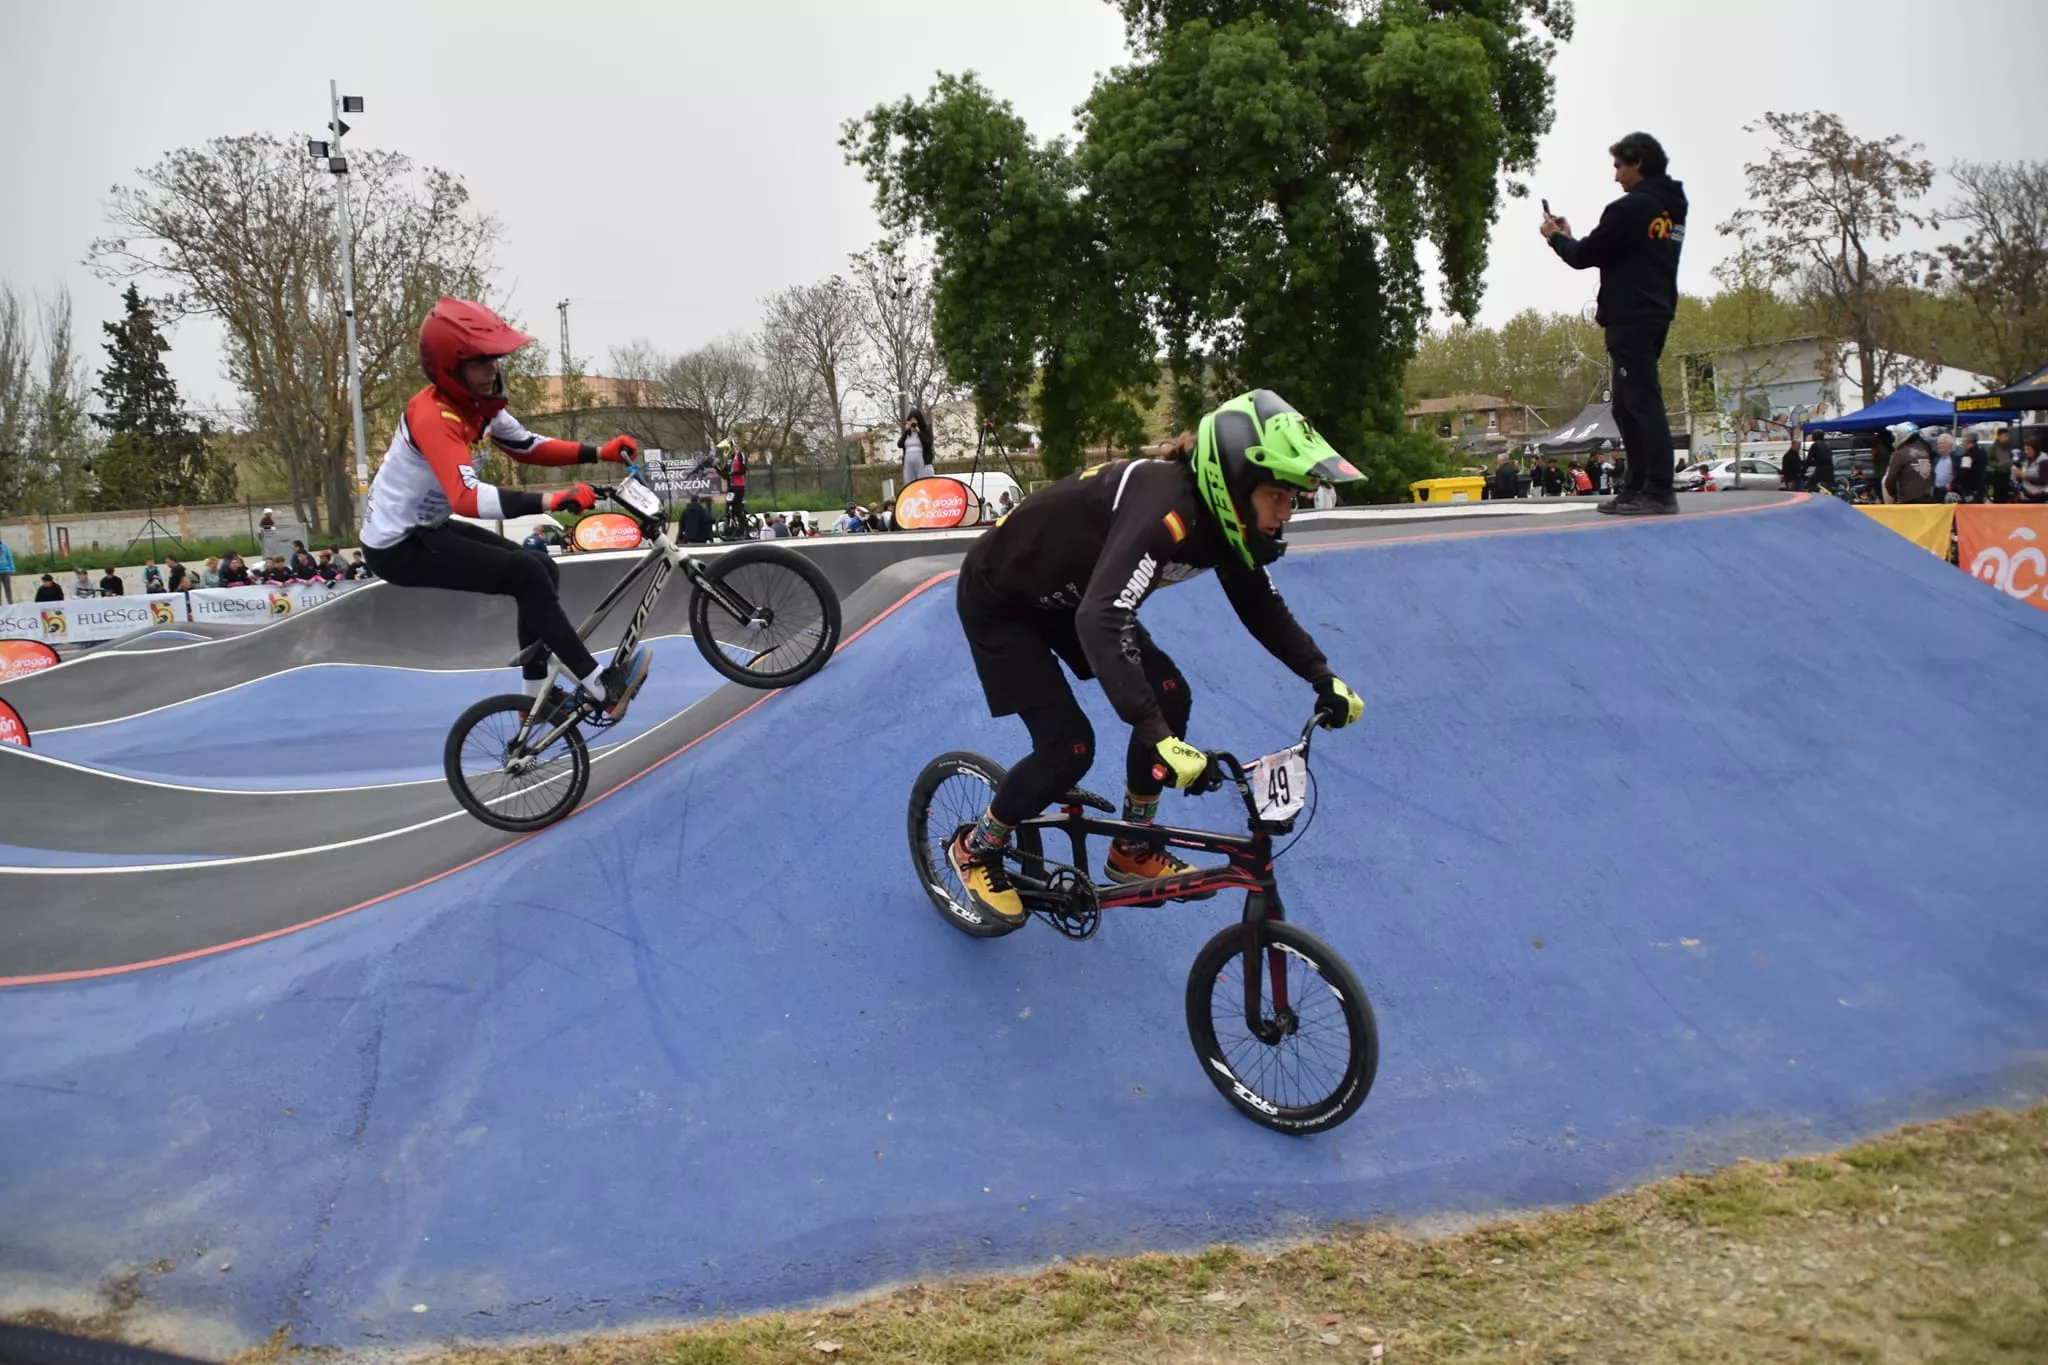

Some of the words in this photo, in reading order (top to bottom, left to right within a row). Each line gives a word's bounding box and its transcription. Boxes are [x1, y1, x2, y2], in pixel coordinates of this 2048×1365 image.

[648, 459, 695, 468] EXTREME
[651, 470, 685, 480] PARK
[654, 477, 710, 491] MONZÓN
[933, 496, 962, 509] aragón
[1113, 552, 1157, 610] SCHOOL
[615, 557, 671, 668] CHASE
[1268, 766, 1290, 808] 49
